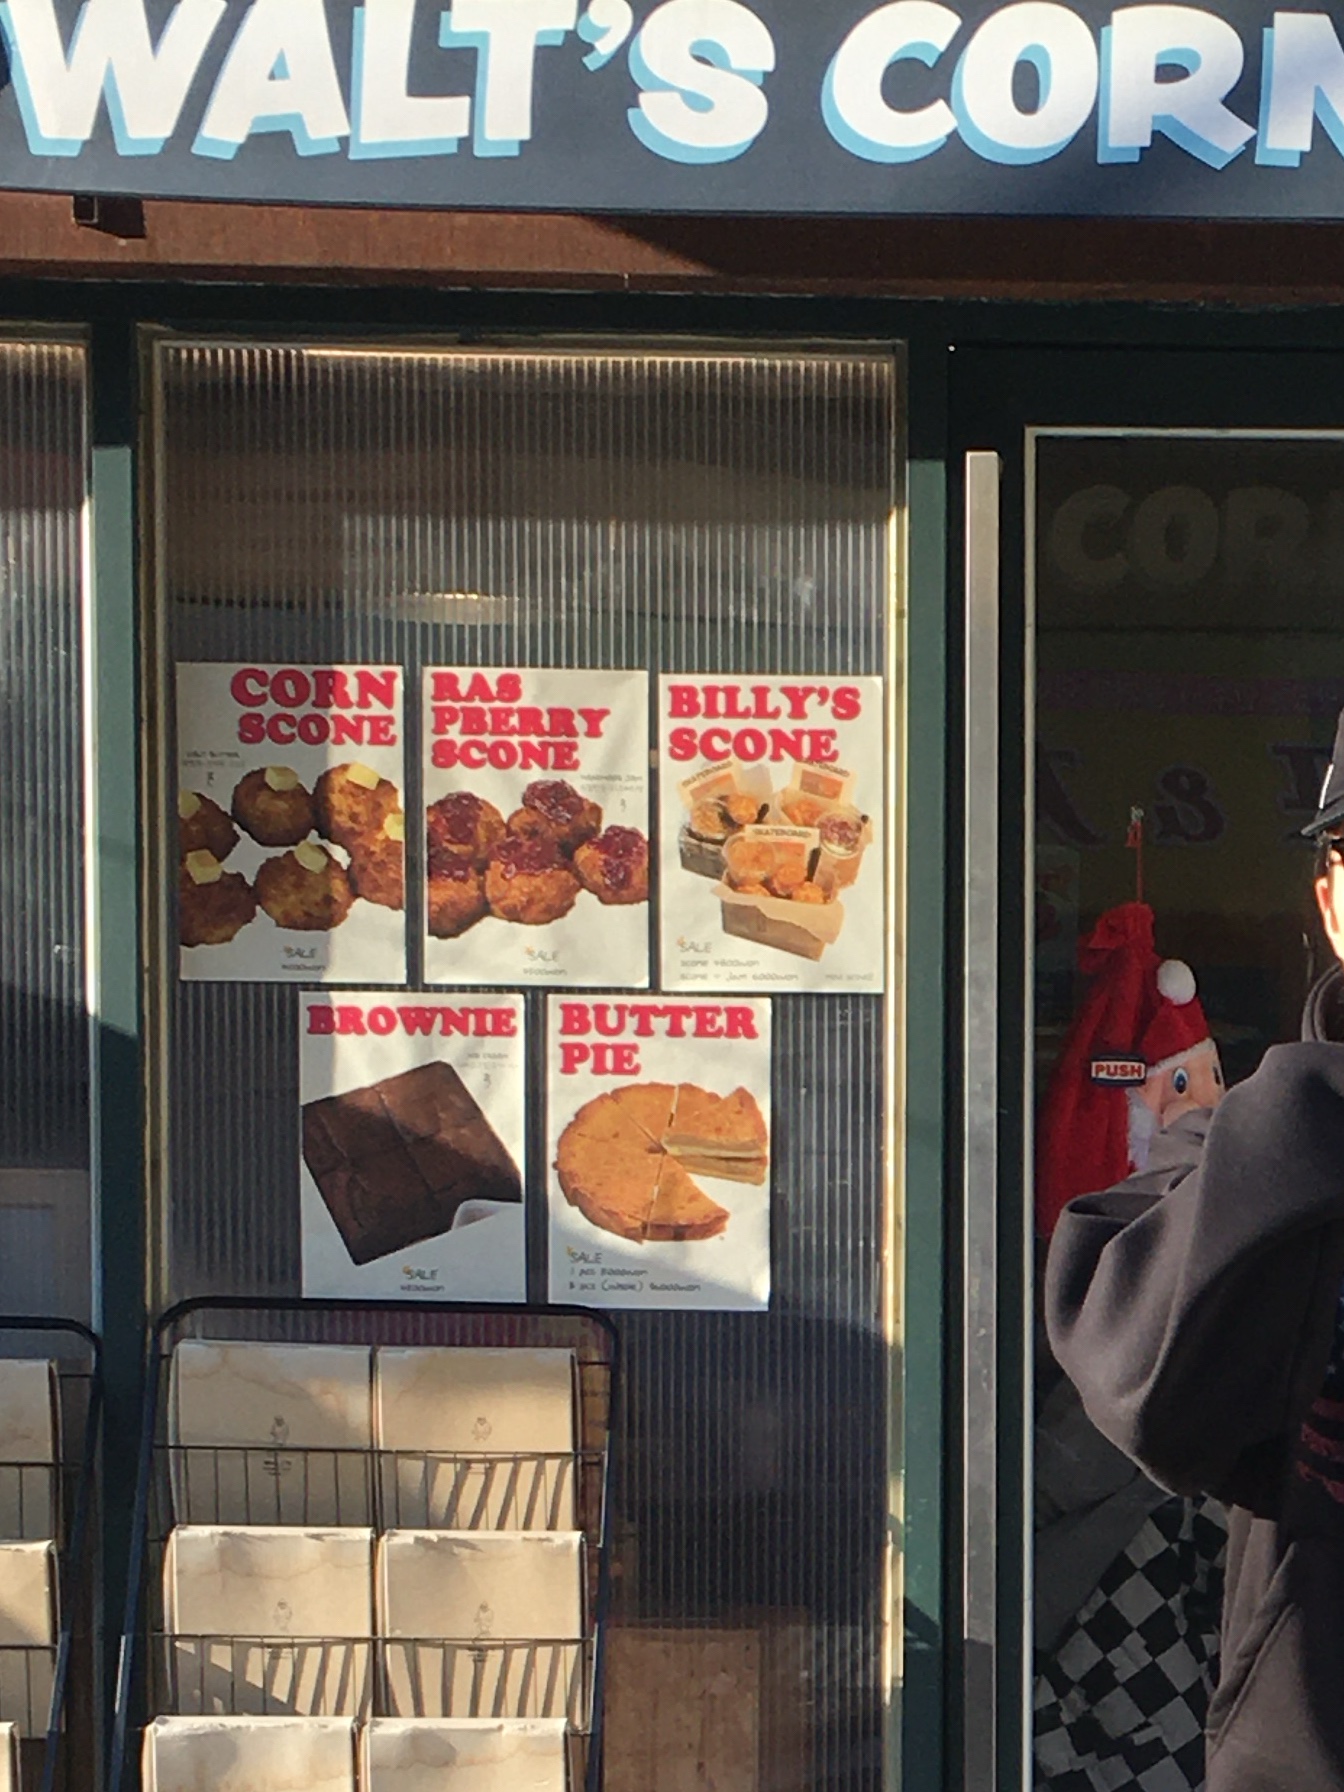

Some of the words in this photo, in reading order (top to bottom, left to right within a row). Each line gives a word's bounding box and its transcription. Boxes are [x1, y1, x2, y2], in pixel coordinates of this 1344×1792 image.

[230, 667, 398, 709] CORN
[430, 672, 523, 703] RAS
[236, 712, 397, 746] SCONE
[430, 706, 611, 738] PBERRY
[430, 740, 581, 771] SCONE
[667, 728, 840, 763] SCONE
[306, 1004, 518, 1038] BROWNIE
[559, 1003, 760, 1040] BUTTER
[559, 1042, 642, 1077] PIE
[1093, 1063, 1143, 1078] PUSH
